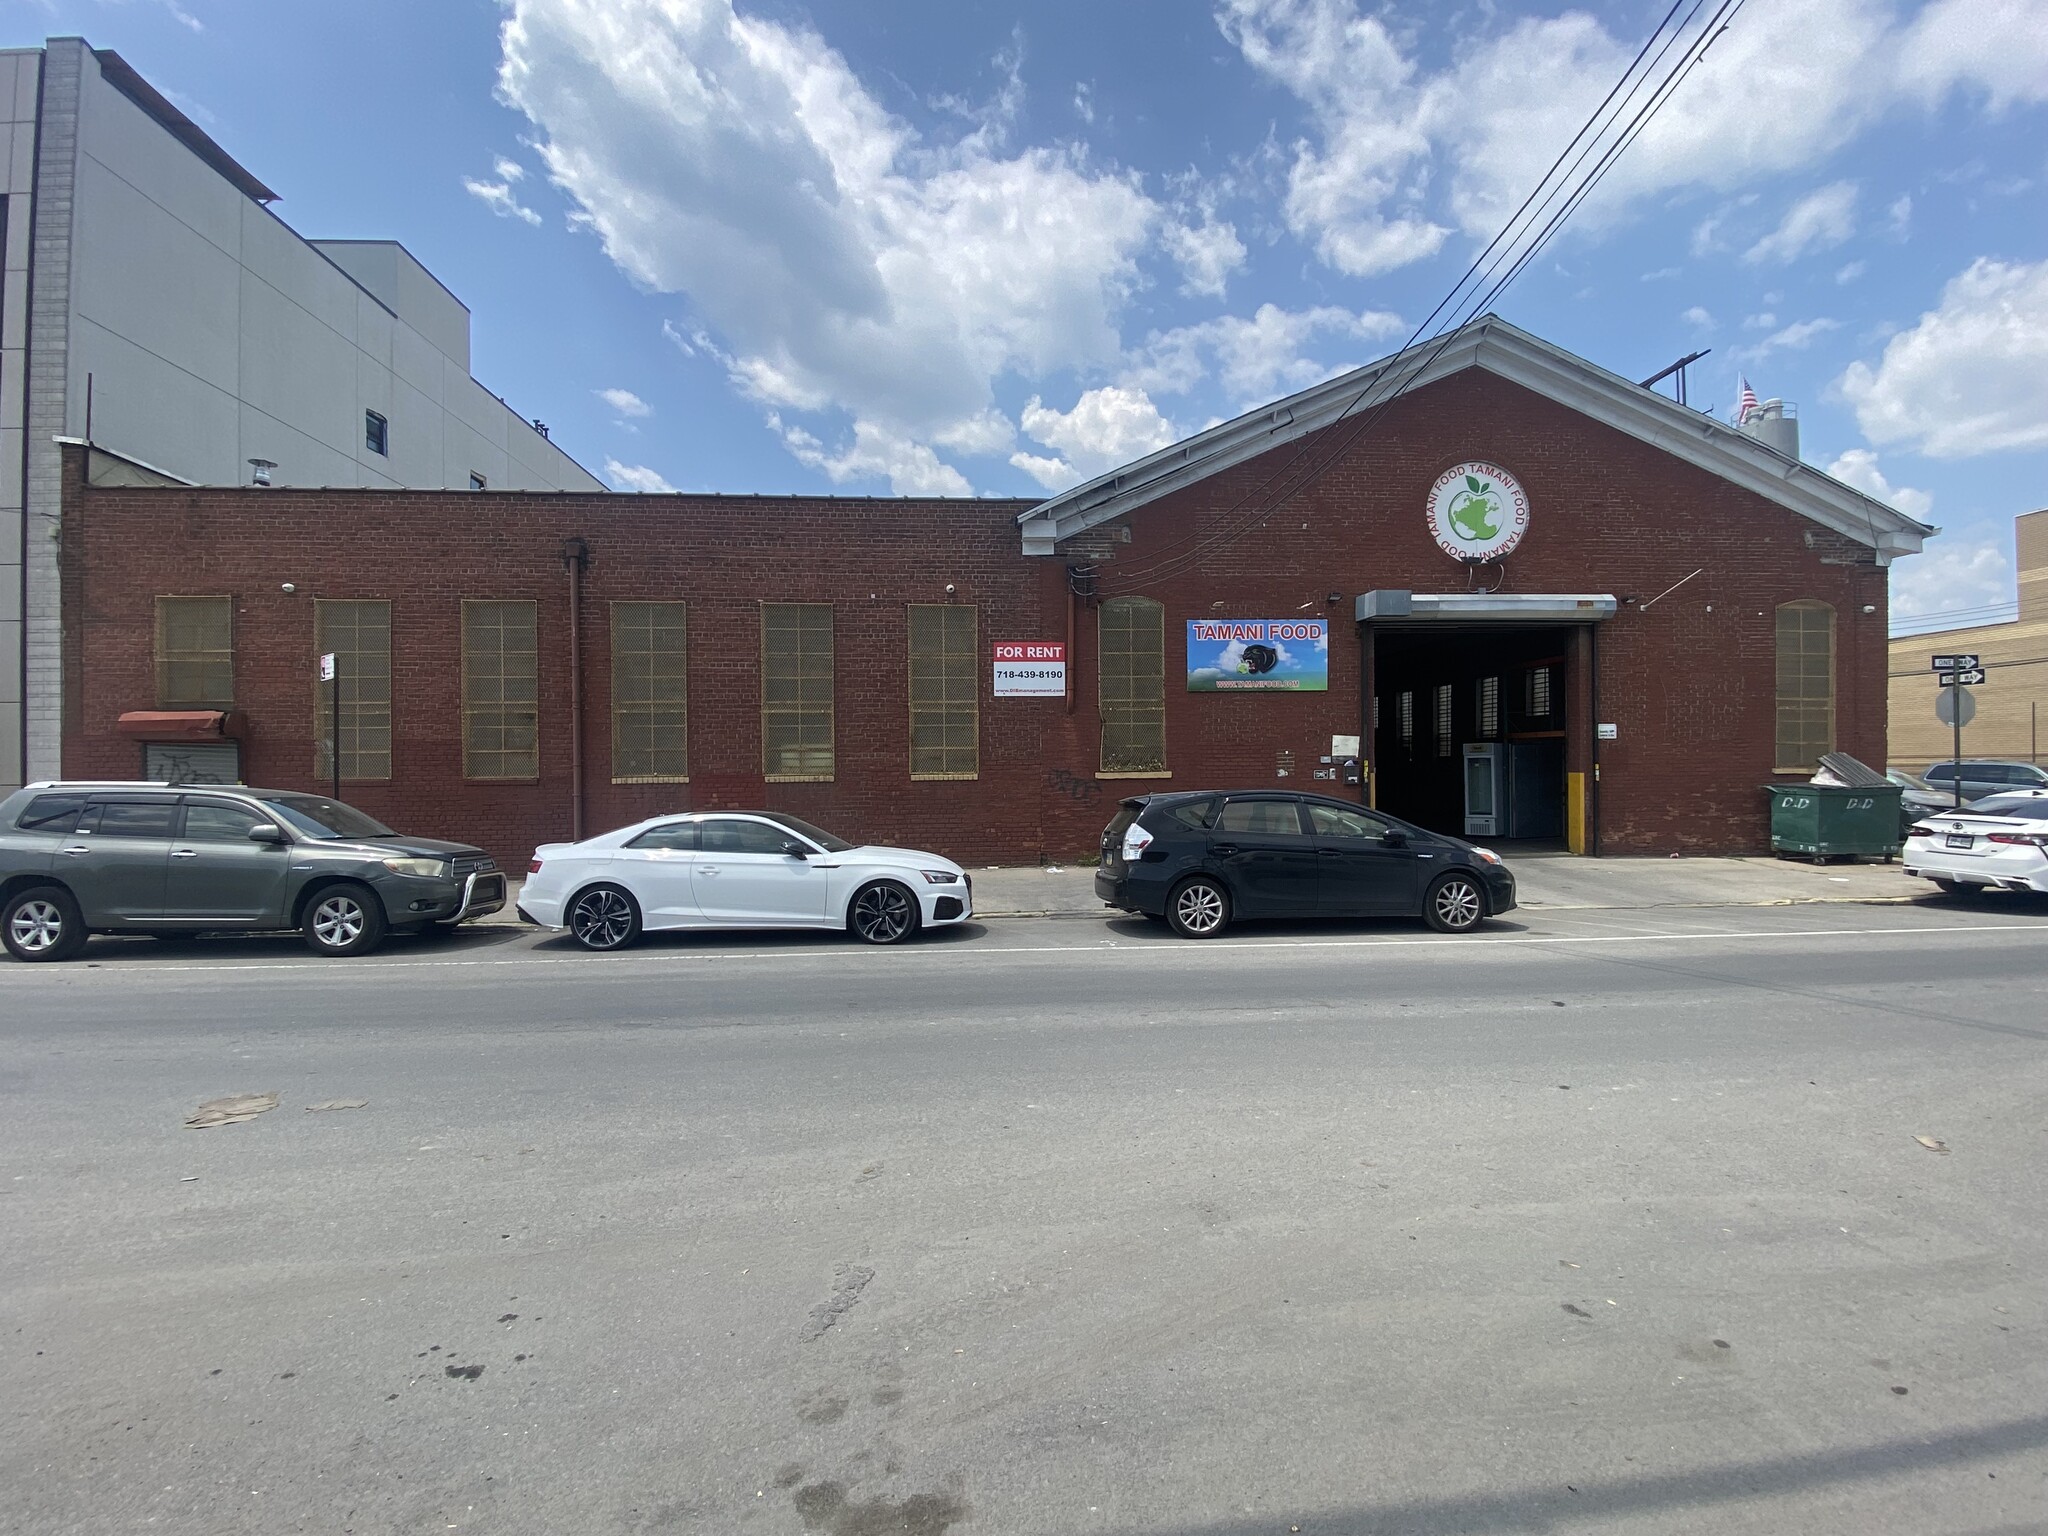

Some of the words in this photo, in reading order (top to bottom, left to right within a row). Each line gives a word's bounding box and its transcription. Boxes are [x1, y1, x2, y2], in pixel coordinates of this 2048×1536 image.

[1426, 493, 1441, 538] TAMANI
[1435, 466, 1466, 491] FOOD
[1469, 464, 1515, 490] TAMANI
[1510, 489, 1526, 525] FOOD
[1193, 624, 1264, 641] TAMANI
[1269, 623, 1322, 641] FOOD
[996, 646, 1023, 658] FOR
[1027, 646, 1062, 658] RENT
[996, 670, 1063, 679] 718-439-8190
